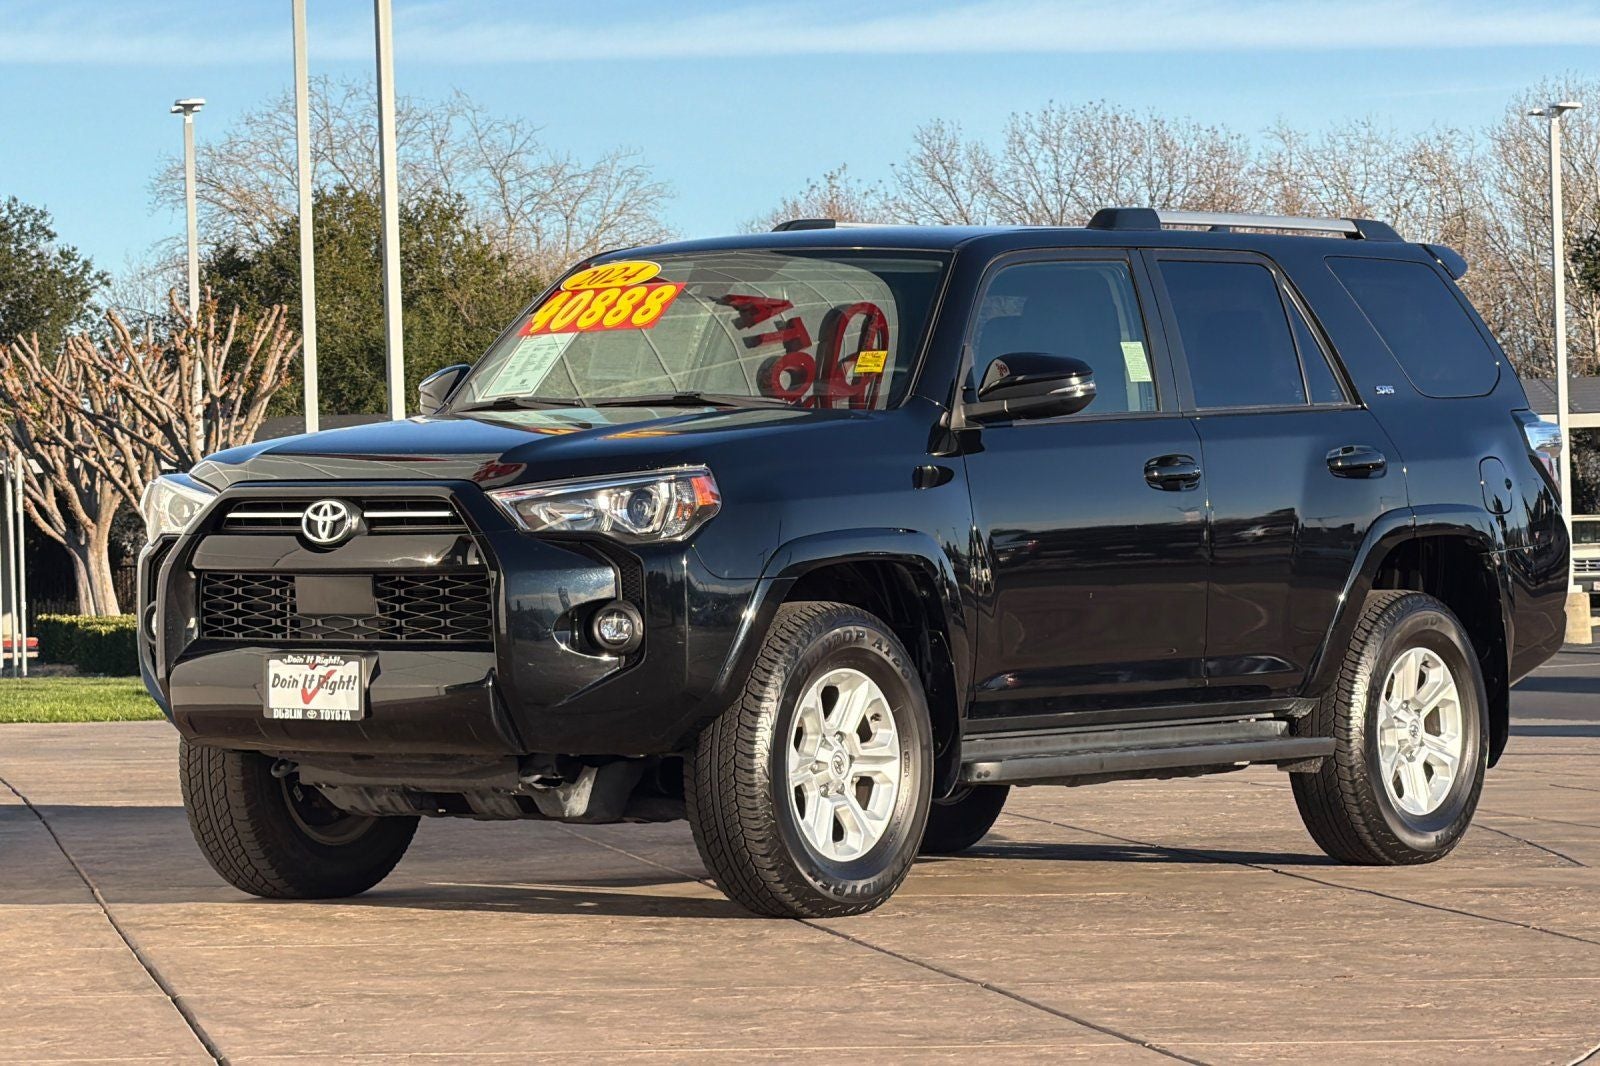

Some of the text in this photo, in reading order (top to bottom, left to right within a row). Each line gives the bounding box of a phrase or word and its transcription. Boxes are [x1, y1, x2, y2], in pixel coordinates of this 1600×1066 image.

[572, 264, 650, 288] 2024
[529, 284, 677, 334] 40888
[271, 673, 358, 695] Doin' It Right!
[273, 708, 351, 721] DUBLIN TOYOTA
